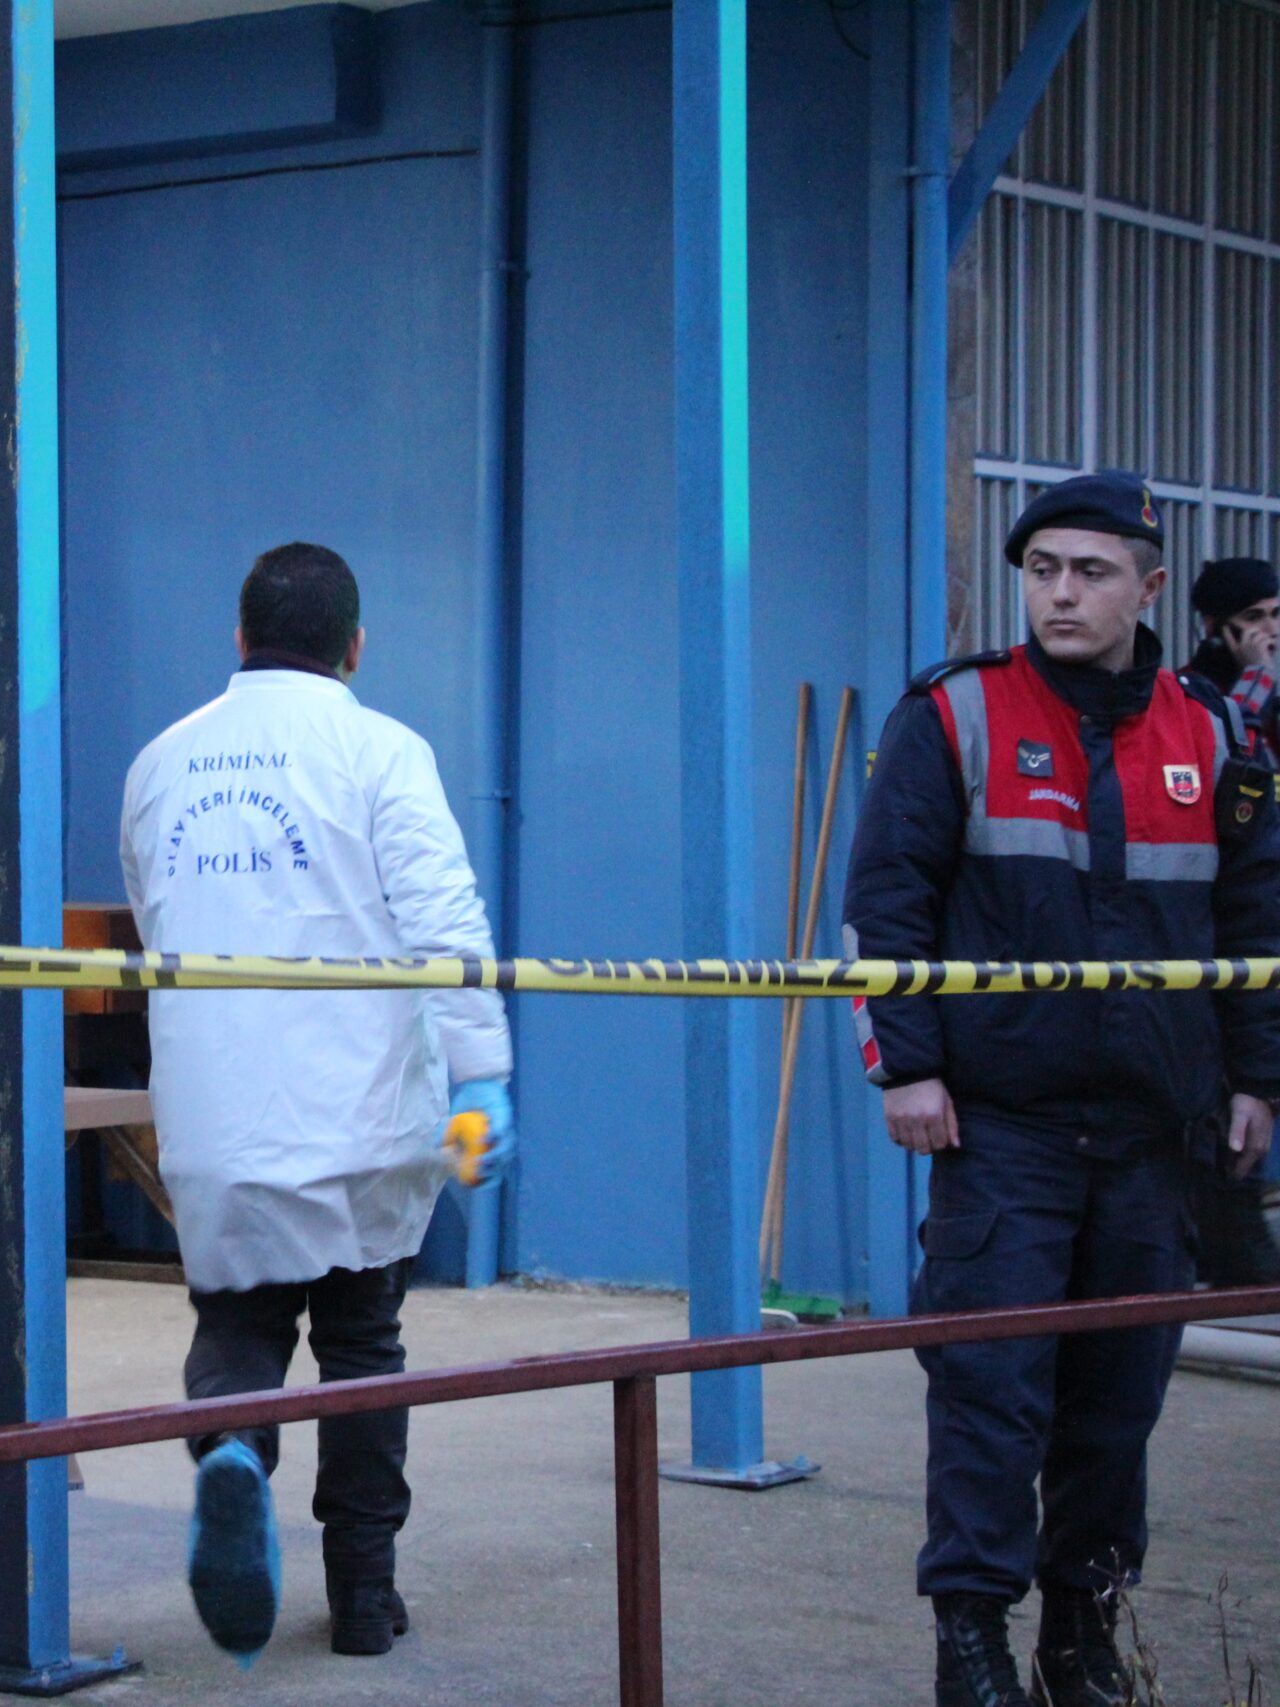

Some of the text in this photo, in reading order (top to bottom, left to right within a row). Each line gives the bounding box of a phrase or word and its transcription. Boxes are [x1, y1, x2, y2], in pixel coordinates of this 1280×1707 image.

[188, 750, 293, 774] KRİMİNAL
[186, 785, 233, 819] YERİ
[239, 785, 309, 871] İNCELEME
[197, 847, 272, 875] POLİS
